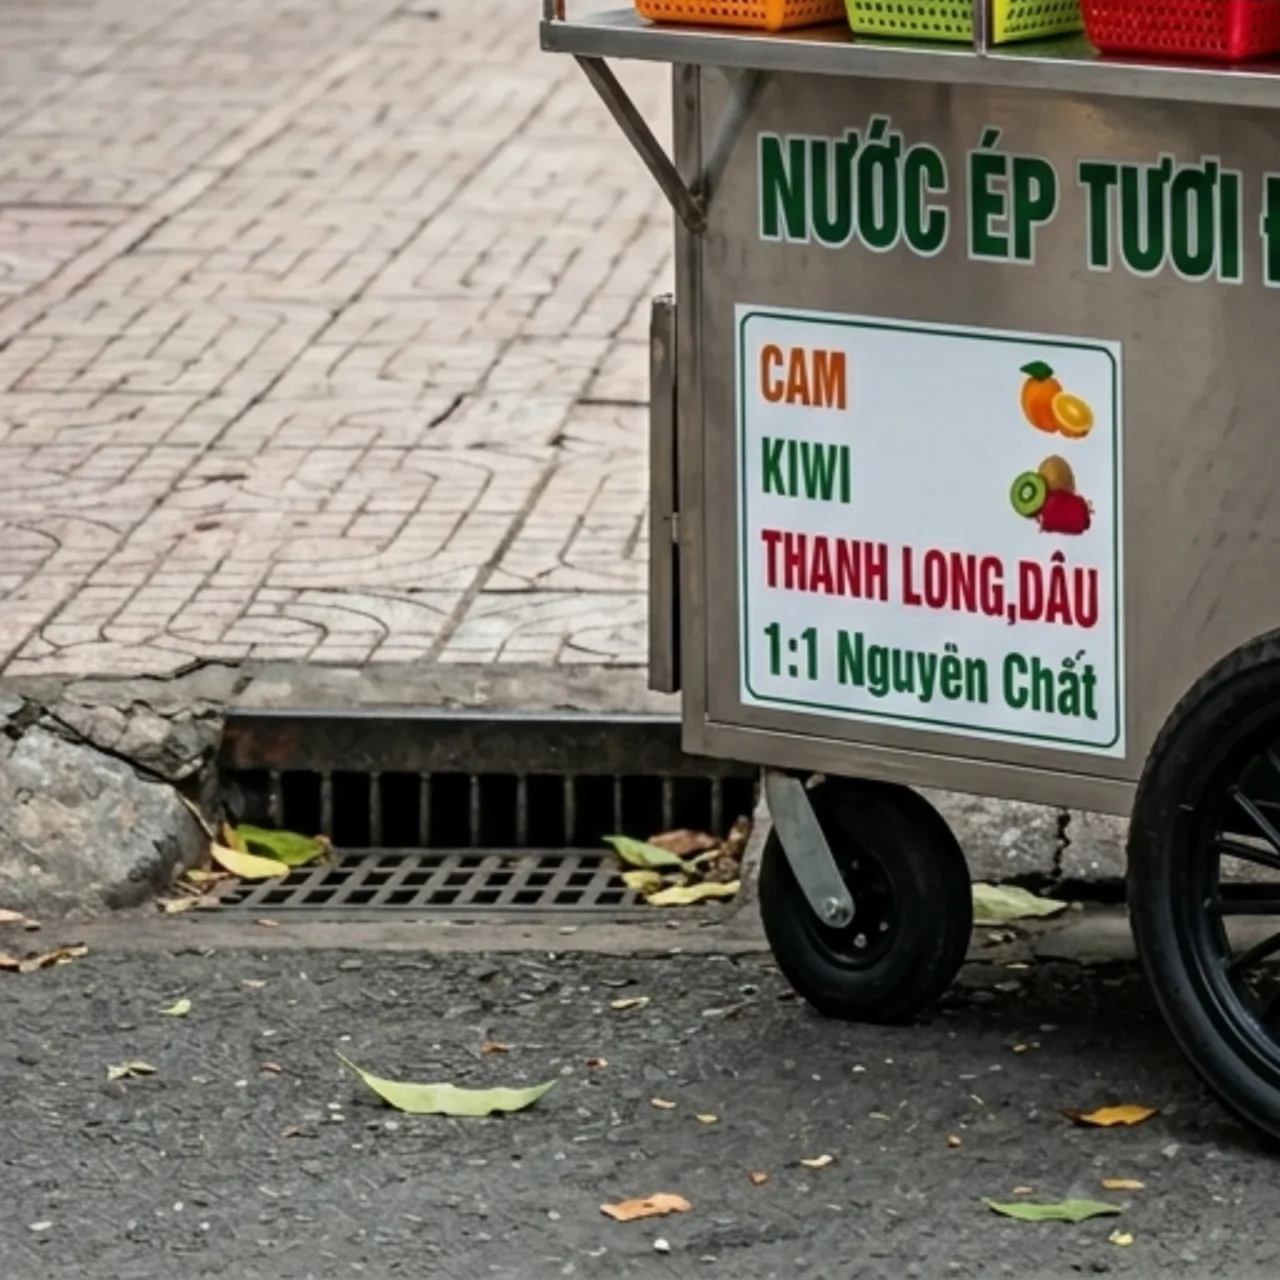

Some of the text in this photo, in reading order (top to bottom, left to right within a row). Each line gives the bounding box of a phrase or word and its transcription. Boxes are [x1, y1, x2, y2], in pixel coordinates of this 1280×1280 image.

[757, 114, 949, 258] NƯỚC
[967, 126, 1060, 265] ÉP
[1077, 153, 1243, 285] TƯƠI
[760, 344, 847, 410] CAM
[761, 436, 851, 504] KIWI
[761, 528, 888, 602] THANH
[764, 621, 1098, 720] 1:1 Nguyên Chất
